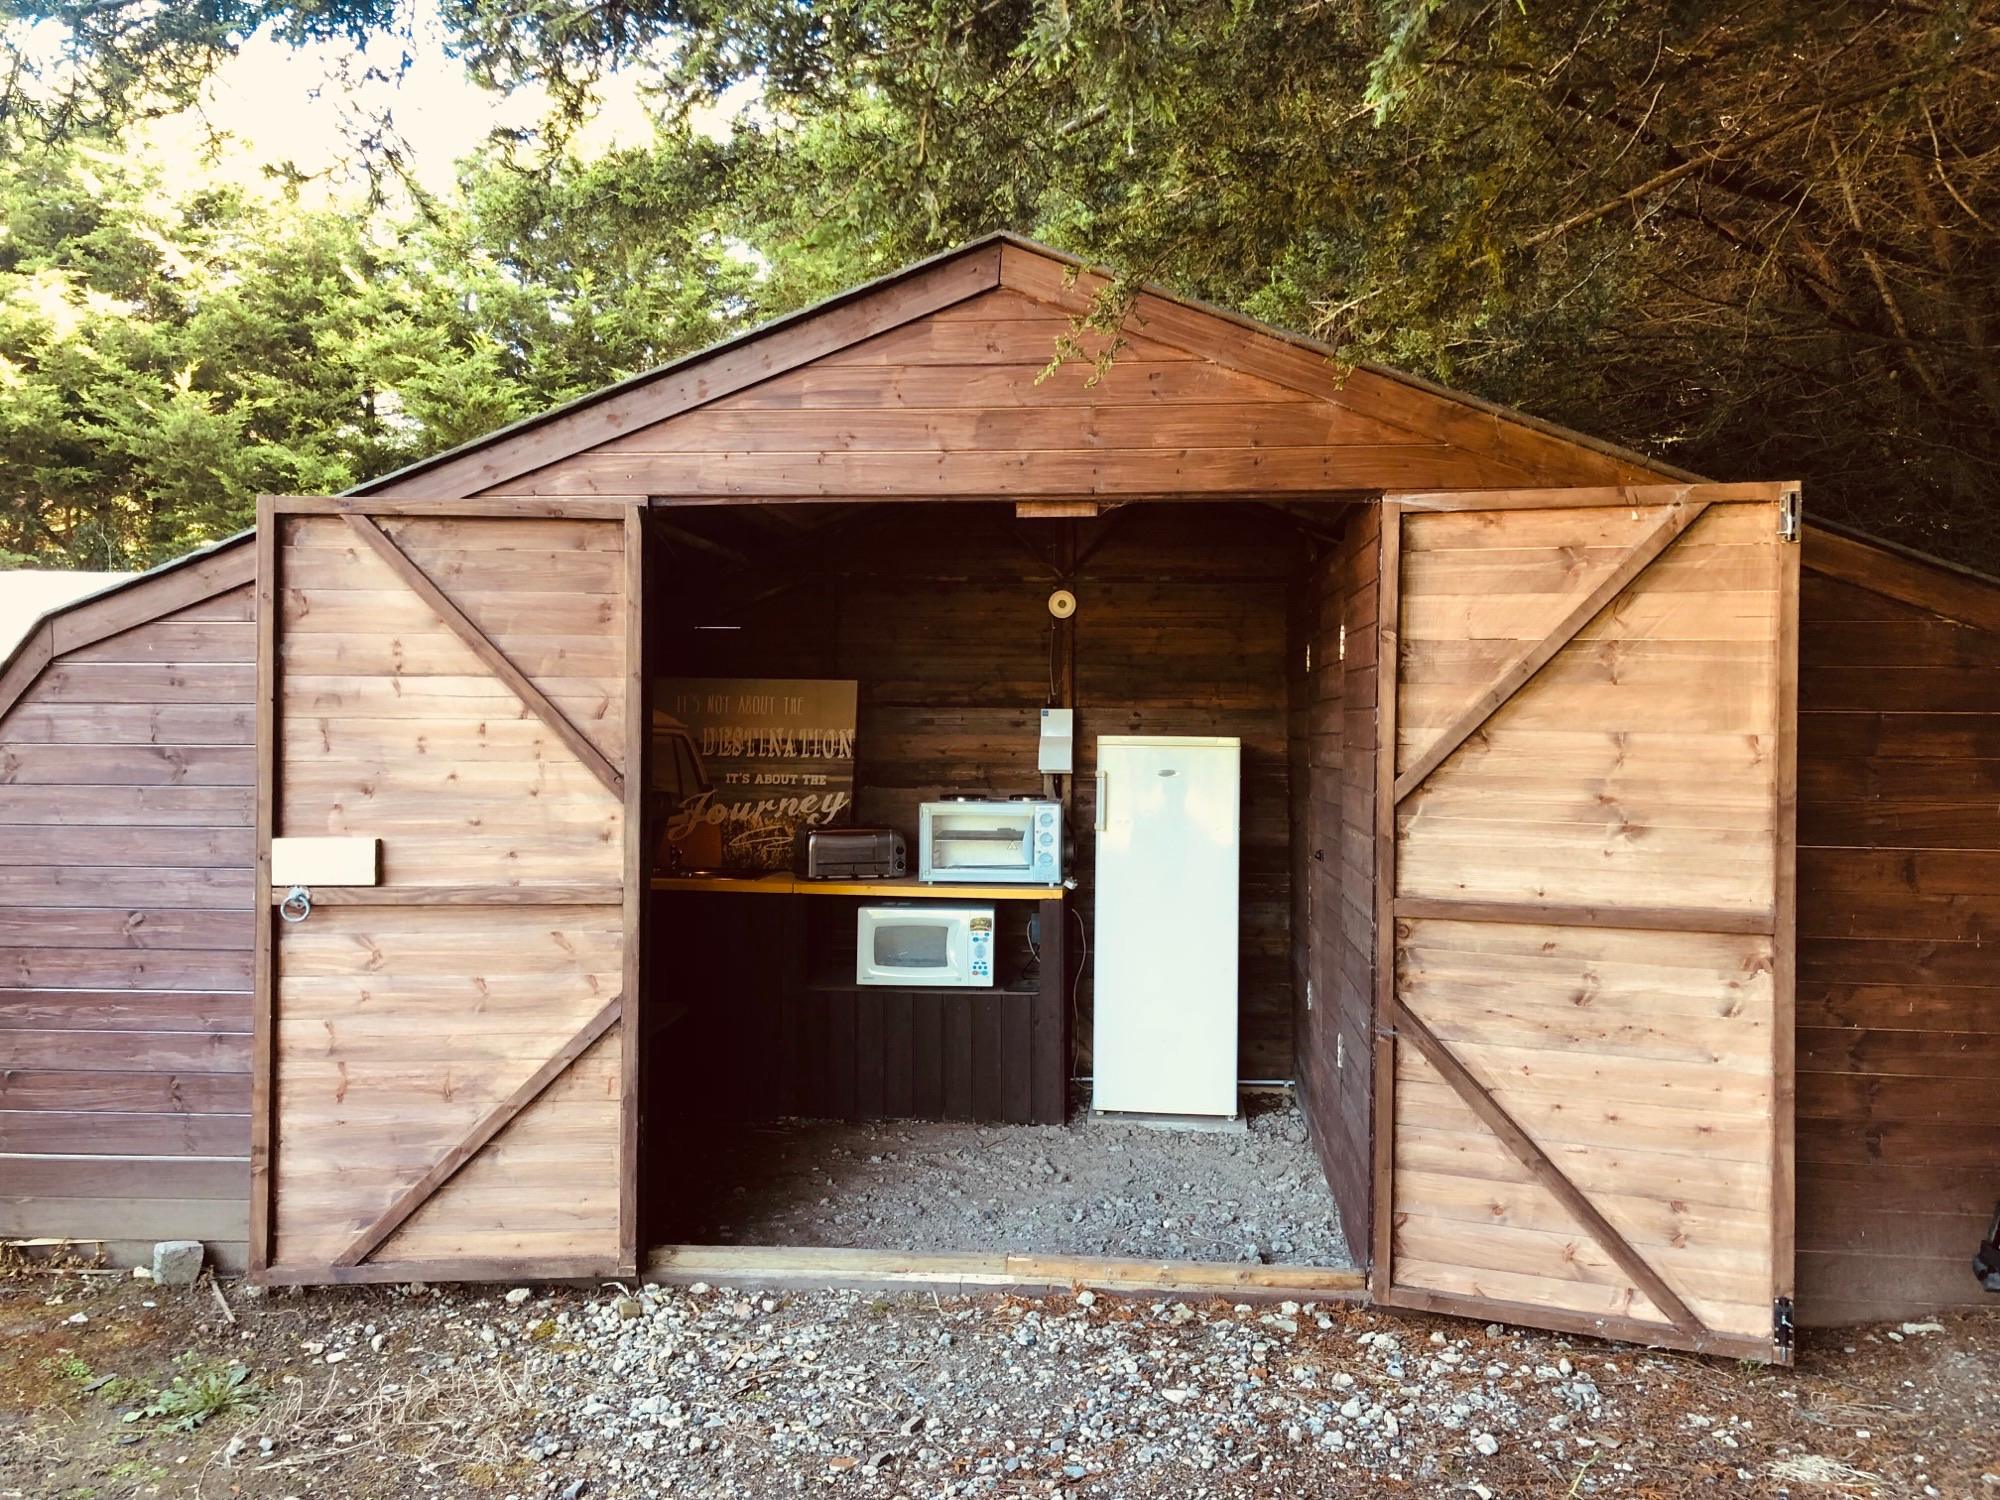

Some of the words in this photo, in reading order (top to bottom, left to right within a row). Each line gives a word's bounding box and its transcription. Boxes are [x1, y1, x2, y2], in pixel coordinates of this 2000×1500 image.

[676, 695, 700, 715] IT'S
[707, 695, 731, 714] NOT
[737, 695, 776, 715] ABOUT
[784, 696, 805, 716] THE
[701, 726, 855, 759] DESTINATION
[726, 772, 750, 784] IT'S
[754, 773, 798, 785] ABOUT
[802, 774, 827, 786] THE
[667, 789, 850, 841] Journey
